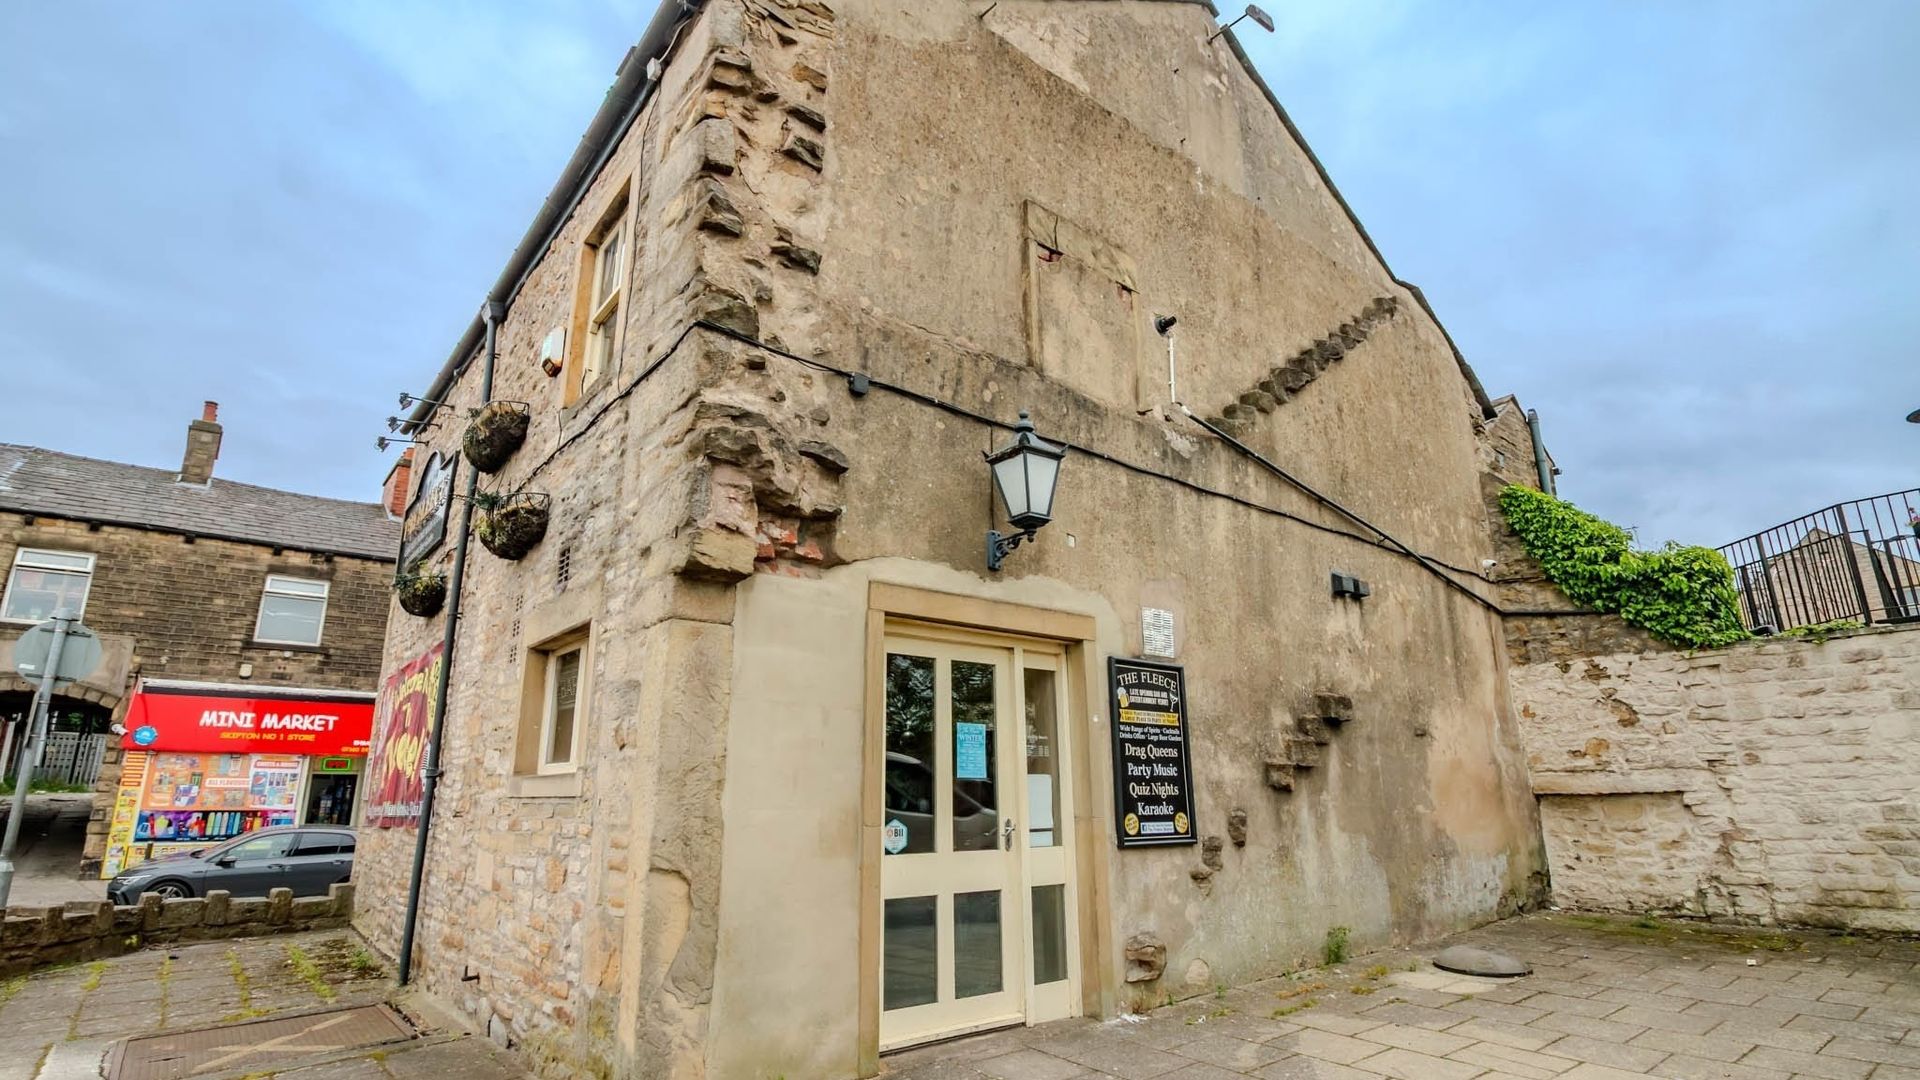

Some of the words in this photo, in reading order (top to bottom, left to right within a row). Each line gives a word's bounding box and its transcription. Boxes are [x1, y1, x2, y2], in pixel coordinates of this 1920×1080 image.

[1117, 672, 1138, 686] THE
[1140, 671, 1177, 692] FLEECE
[199, 710, 256, 729] MINI
[261, 713, 339, 732] MARKET
[287, 733, 316, 742] STORE
[1124, 742, 1147, 760] Drag
[1147, 743, 1178, 760] Queens
[1127, 762, 1152, 779] Party
[1153, 763, 1178, 777] Music
[1129, 782, 1151, 798] Quiz
[1151, 782, 1179, 799] Nights
[1137, 801, 1174, 816] Karaoke
